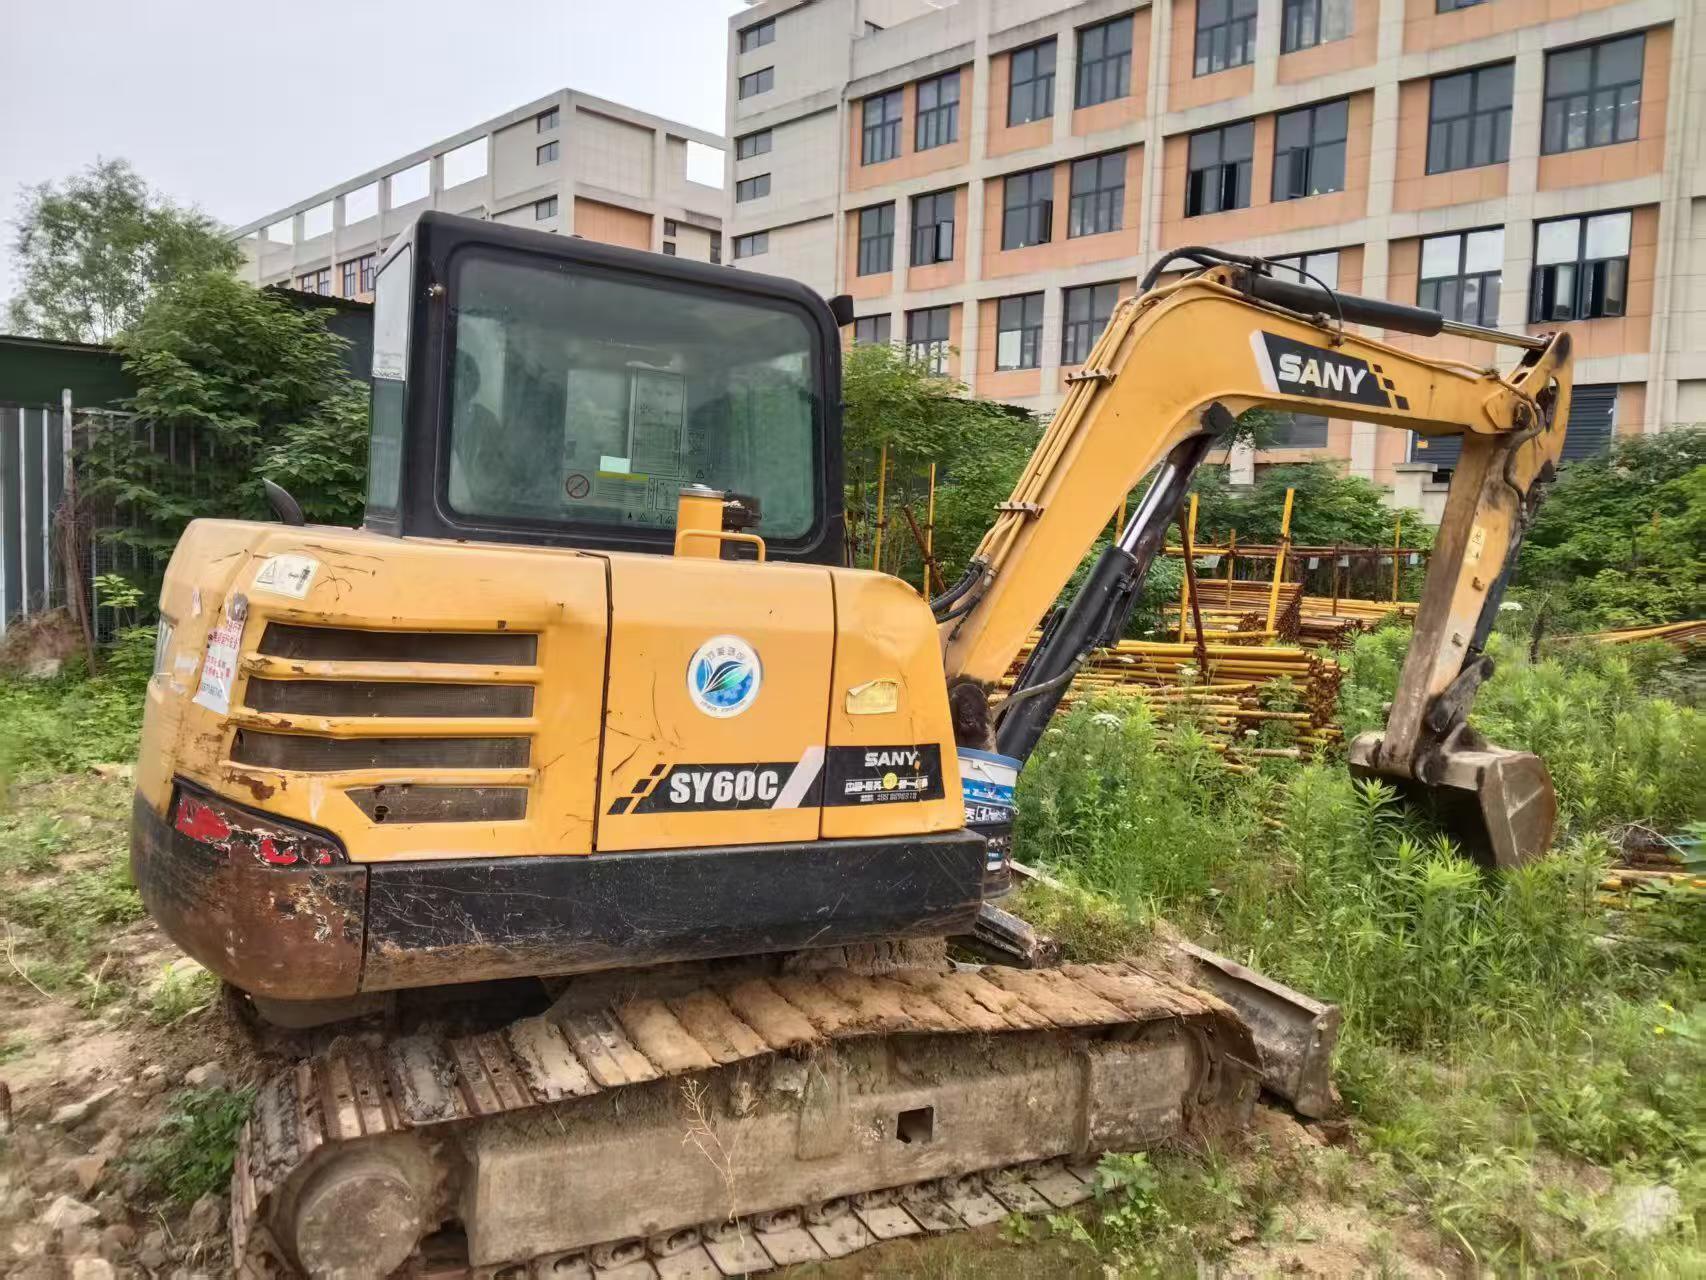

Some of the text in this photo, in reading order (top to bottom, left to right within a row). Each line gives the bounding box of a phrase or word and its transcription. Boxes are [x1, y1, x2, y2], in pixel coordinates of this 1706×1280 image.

[1278, 353, 1367, 394] SANY
[864, 751, 918, 767] SANY
[669, 770, 779, 804] SY60C
